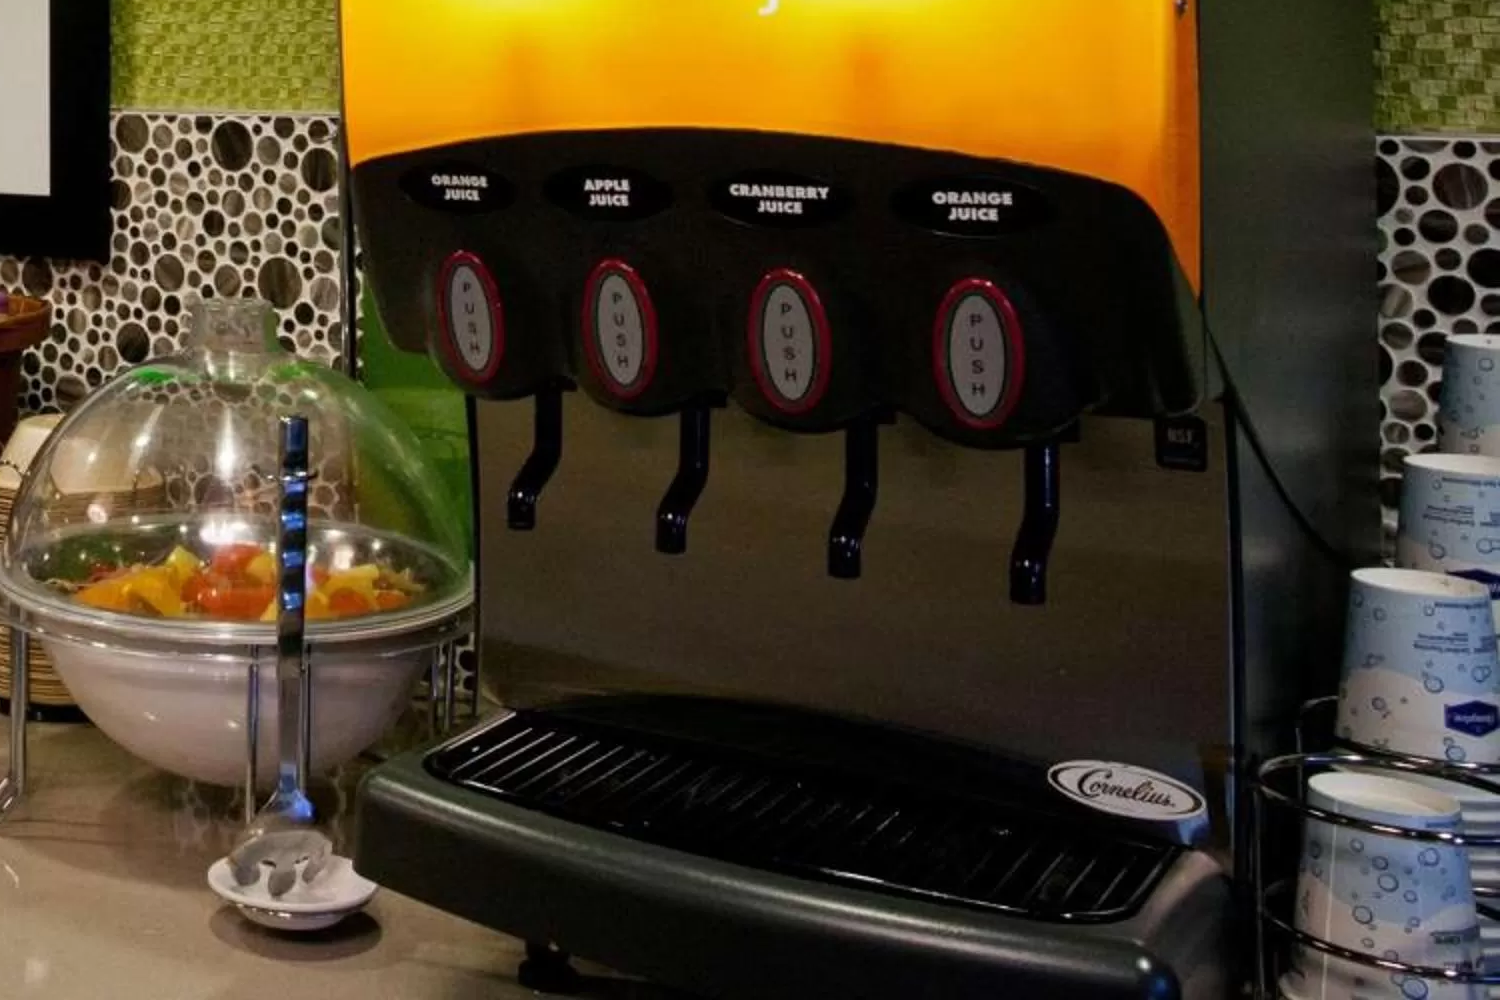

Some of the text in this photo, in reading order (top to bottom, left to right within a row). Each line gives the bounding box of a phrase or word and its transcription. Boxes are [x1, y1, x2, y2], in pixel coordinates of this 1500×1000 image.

[430, 173, 489, 189] ORANGE
[583, 178, 631, 192] APPLE
[443, 187, 481, 201] JUICE
[728, 183, 830, 200] CRANBERRY
[931, 191, 1014, 206] ORANGE
[588, 193, 630, 207] JUICE
[756, 200, 803, 215] JUICE
[947, 206, 1000, 222] JUICE
[462, 281, 481, 356] PUSH
[611, 291, 630, 369] PUSH
[780, 302, 798, 382] PUSH
[969, 312, 986, 397] PUSH
[1076, 767, 1176, 808] Cornelius
